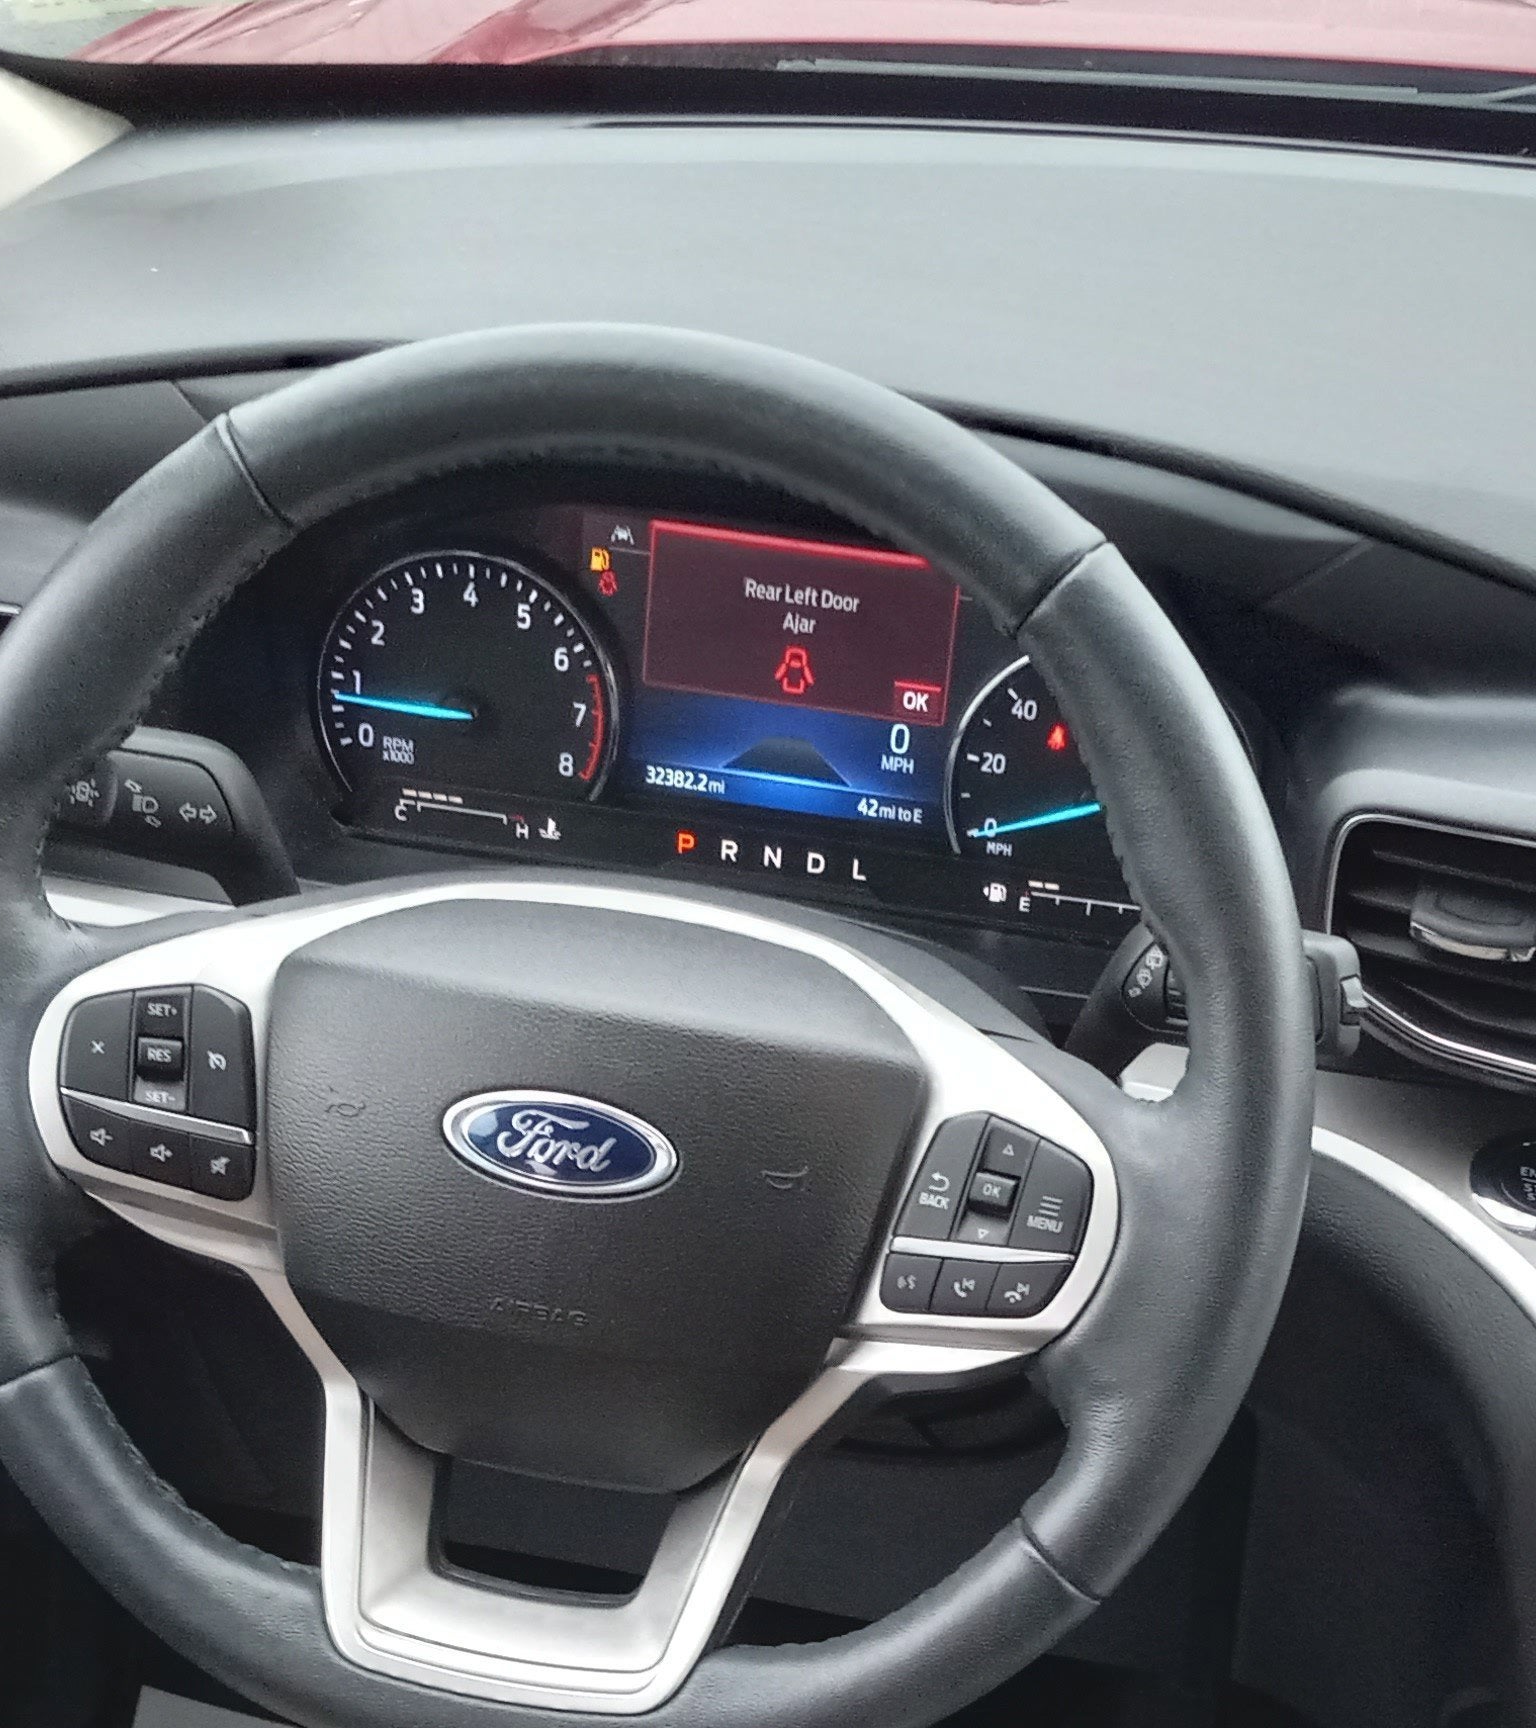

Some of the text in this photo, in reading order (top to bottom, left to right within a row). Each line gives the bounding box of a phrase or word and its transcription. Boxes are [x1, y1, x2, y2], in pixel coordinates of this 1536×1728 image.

[411, 588, 425, 614] 3
[463, 583, 478, 607] 4
[744, 578, 860, 613] Rear Left Door
[516, 604, 532, 629] 5
[782, 611, 816, 635] Ajar
[370, 621, 385, 646] 2
[554, 648, 569, 672] 6
[351, 670, 362, 693] 1
[902, 691, 928, 712] OK
[1011, 698, 1037, 721] 40
[572, 703, 587, 727] 7
[359, 723, 374, 748] 0
[382, 735, 414, 753] RPM
[890, 723, 910, 755] 0
[382, 748, 415, 765] x1000
[558, 753, 574, 777] 8
[881, 755, 914, 775] MPH
[980, 752, 1006, 774] 20
[394, 804, 408, 821] C
[857, 798, 878, 819] 42
[897, 806, 912, 823] to
[913, 807, 923, 824] E
[516, 822, 529, 840] H
[677, 832, 866, 881] P R N D L
[986, 842, 1012, 857] MPH
[1019, 896, 1031, 912] E
[147, 1048, 172, 1063] RES
[496, 1108, 618, 1174] Ford
[919, 1191, 950, 1210] BACK
[982, 1184, 1001, 1198] OK
[1026, 1215, 1064, 1233] MENU
